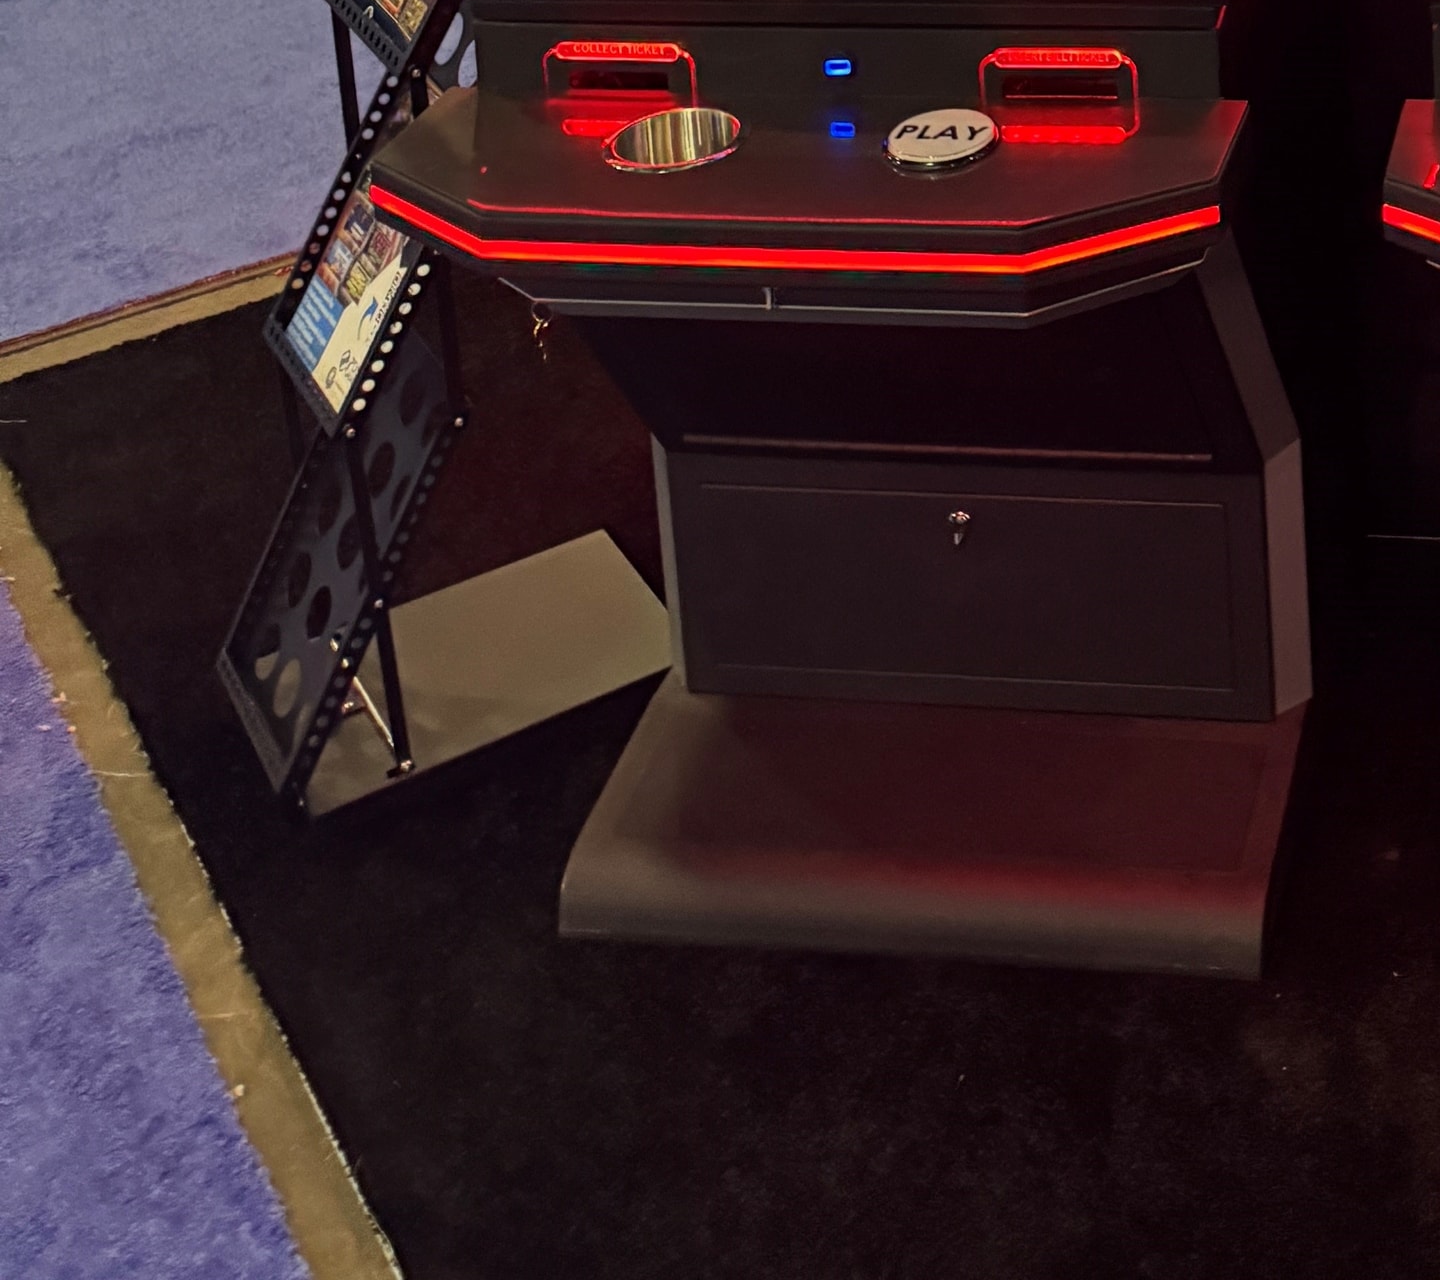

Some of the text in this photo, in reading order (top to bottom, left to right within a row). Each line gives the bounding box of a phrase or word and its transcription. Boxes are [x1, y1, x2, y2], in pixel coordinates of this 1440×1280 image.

[573, 44, 665, 55] COLLECT TICKET
[895, 125, 989, 140] PLAY
